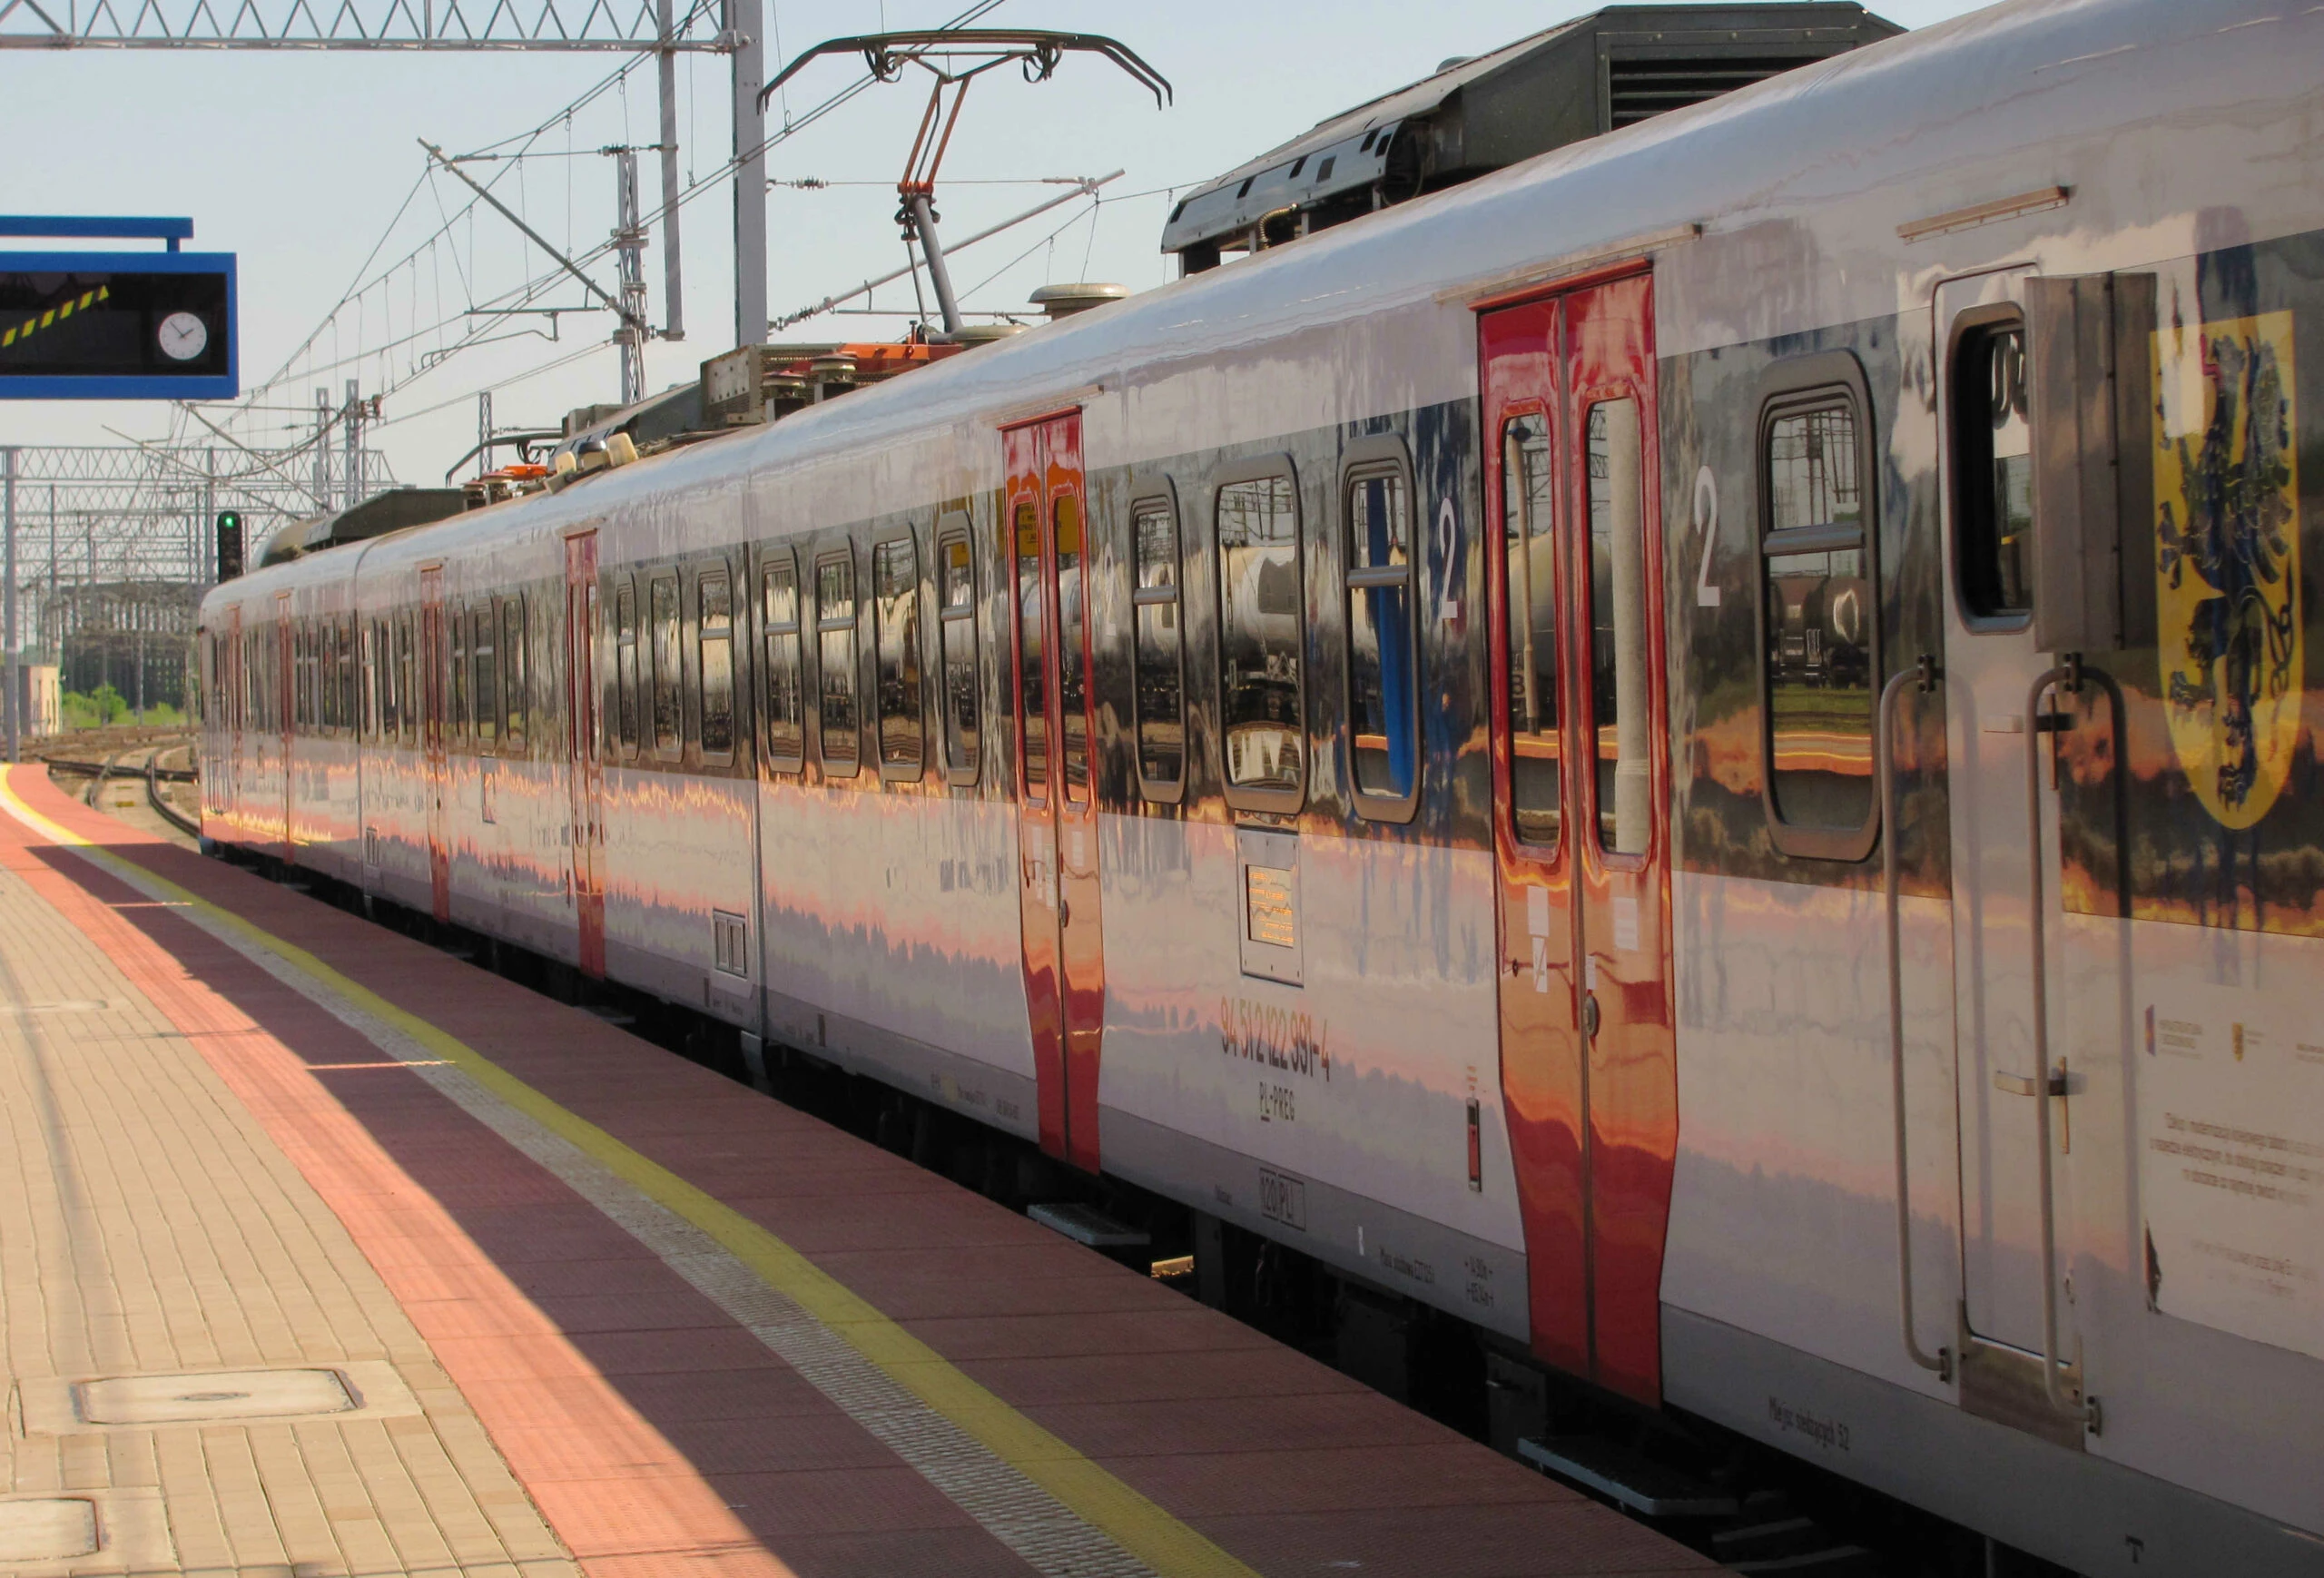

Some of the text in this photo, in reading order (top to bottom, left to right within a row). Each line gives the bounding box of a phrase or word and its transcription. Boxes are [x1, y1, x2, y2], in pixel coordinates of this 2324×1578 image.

[1439, 498, 1458, 618] 2
[1695, 465, 1720, 607] 2
[1221, 995, 1330, 1082] 94 51 2 122 991-4
[1259, 1081, 1295, 1122] PL-PREG
